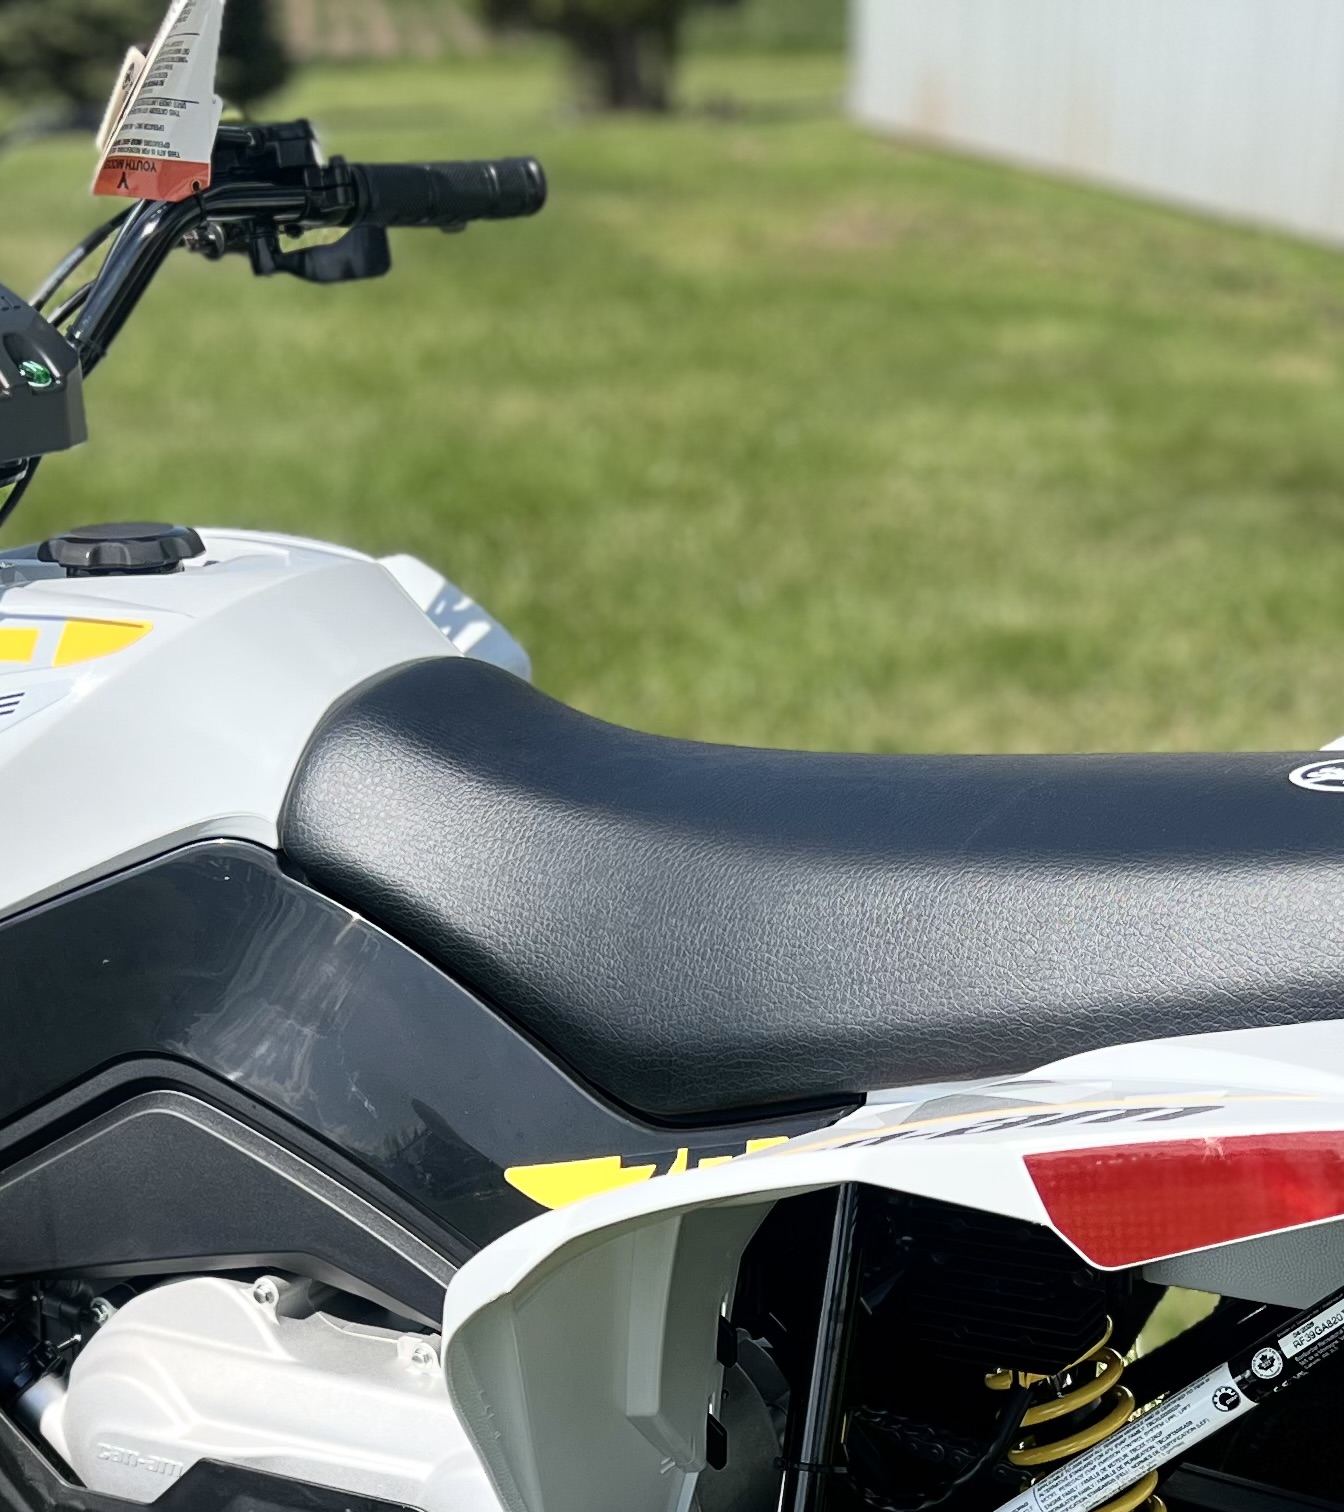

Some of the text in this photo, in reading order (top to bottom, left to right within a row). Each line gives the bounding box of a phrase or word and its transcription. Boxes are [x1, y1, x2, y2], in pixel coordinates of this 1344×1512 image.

[126, 160, 157, 173] YOUTH
[116, 172, 129, 190] Y
[95, 1441, 184, 1478] can-am
